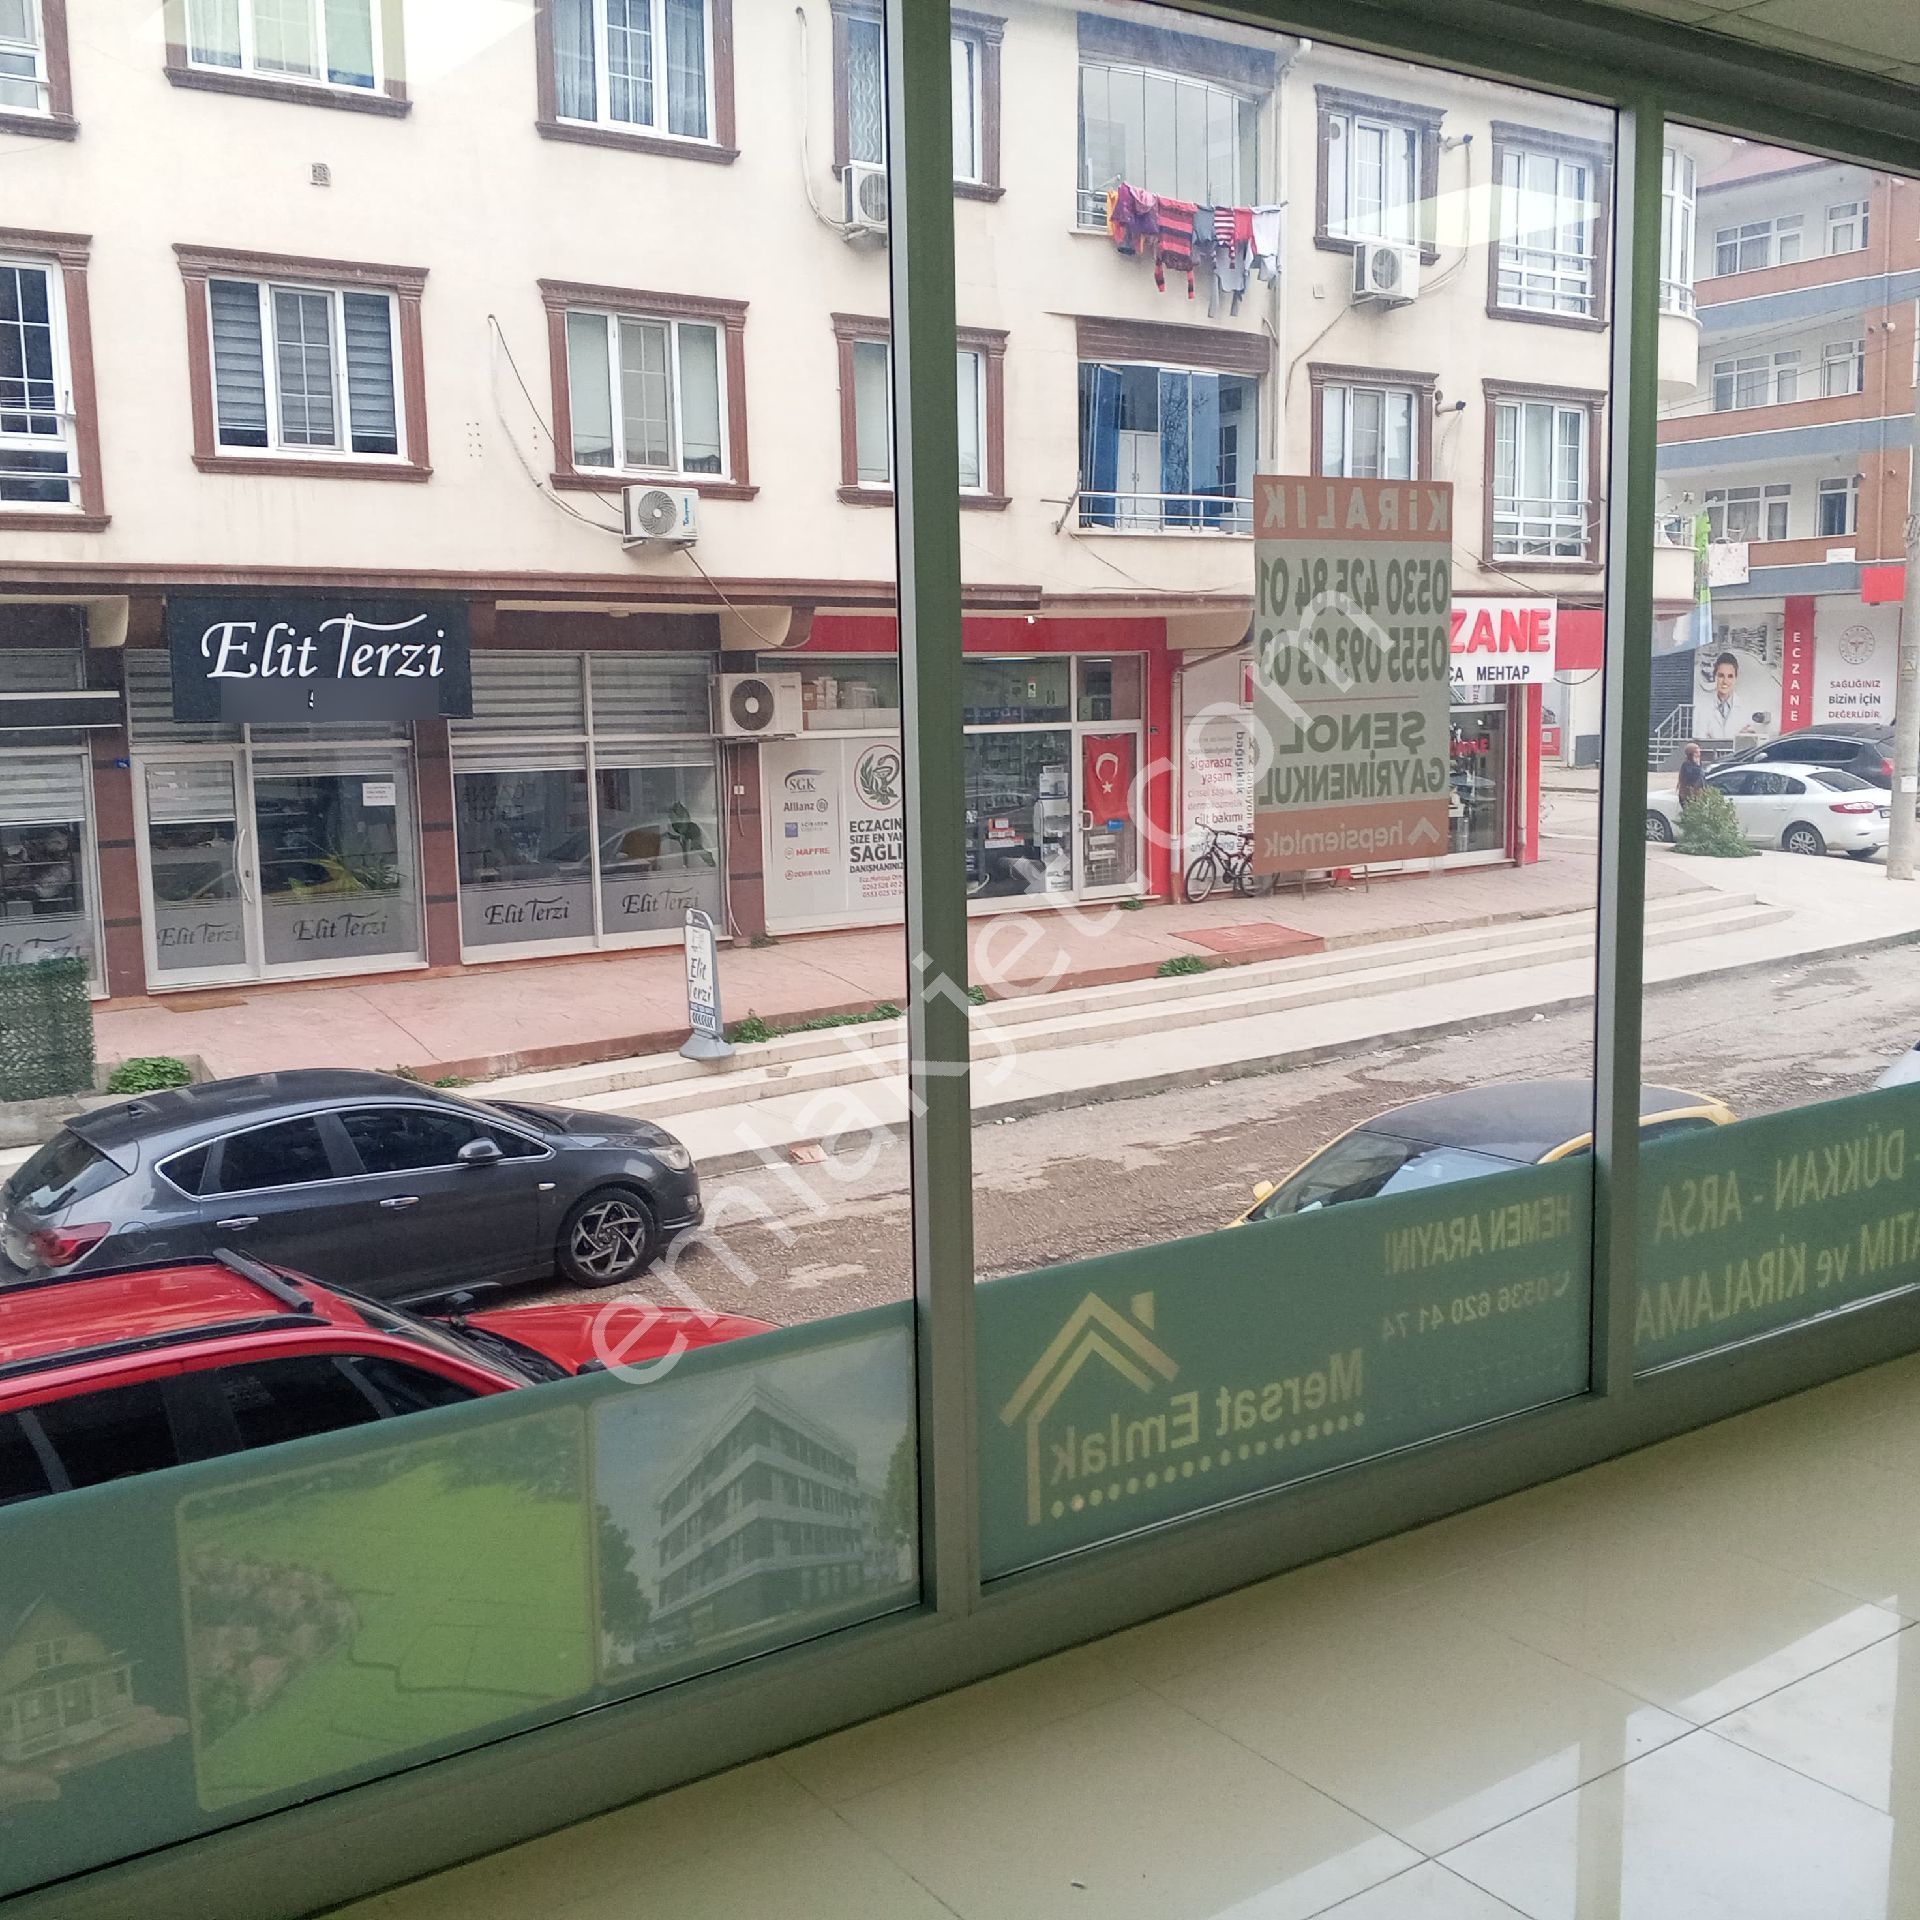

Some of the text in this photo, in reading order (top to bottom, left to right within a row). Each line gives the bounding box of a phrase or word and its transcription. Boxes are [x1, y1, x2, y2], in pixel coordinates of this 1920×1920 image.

[201, 612, 446, 679] Elit Terzi
[1476, 665, 1530, 682] MEHTAP
[1789, 631, 1801, 722] ECZANE
[1829, 693, 1881, 706] BİZİM İÇİN
[1191, 757, 1233, 771] sigarasız
[789, 777, 817, 791] SGK
[1201, 772, 1233, 786] yaşam
[783, 802, 815, 812] Allianz
[873, 833, 885, 843] EN
[796, 847, 831, 857] MAPFRE
[622, 887, 701, 915] Elit Terzi
[484, 896, 571, 926] Elit Terzi
[157, 922, 241, 947] Elit Terzi
[292, 911, 389, 943] Elit Terzi
[690, 957, 707, 981] Elit
